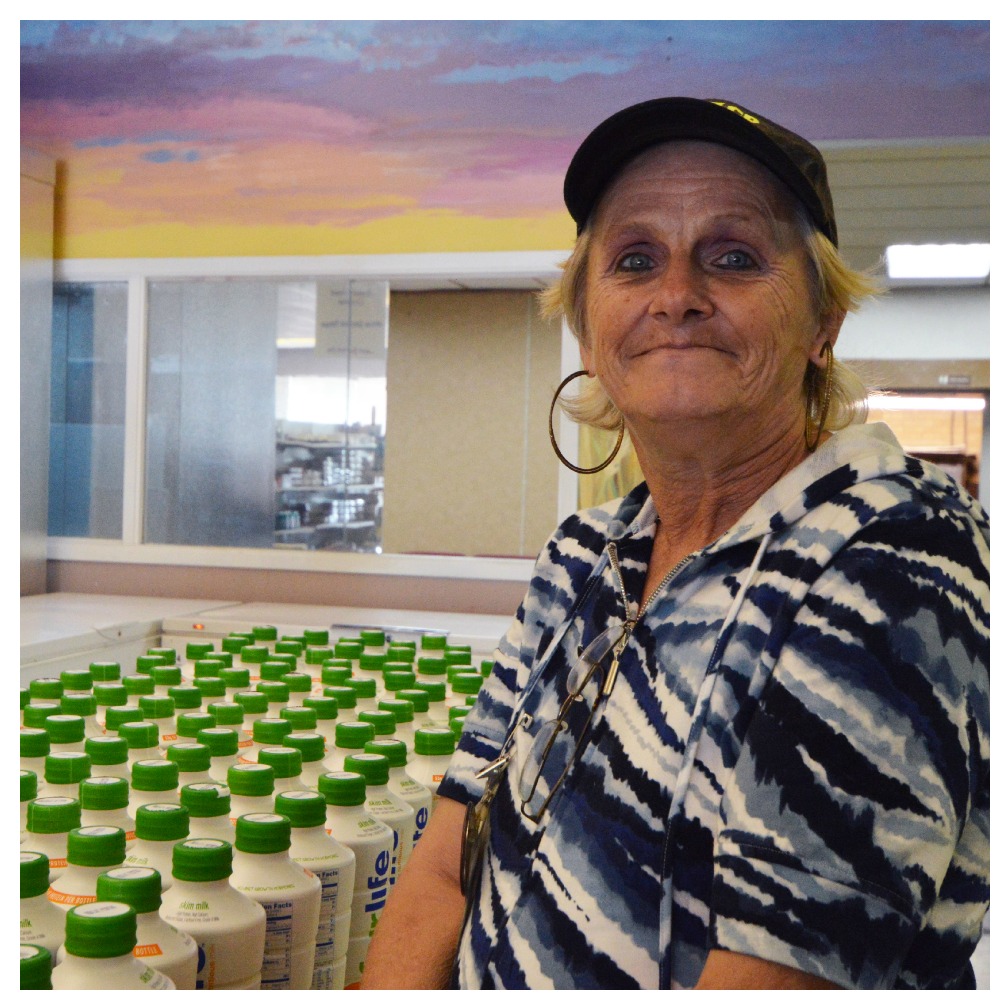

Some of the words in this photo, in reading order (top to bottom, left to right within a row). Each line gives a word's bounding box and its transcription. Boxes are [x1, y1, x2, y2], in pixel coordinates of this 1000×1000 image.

[195, 900, 210, 911] milk
[274, 901, 292, 910] Facts
[135, 945, 158, 956] BOTTLE
